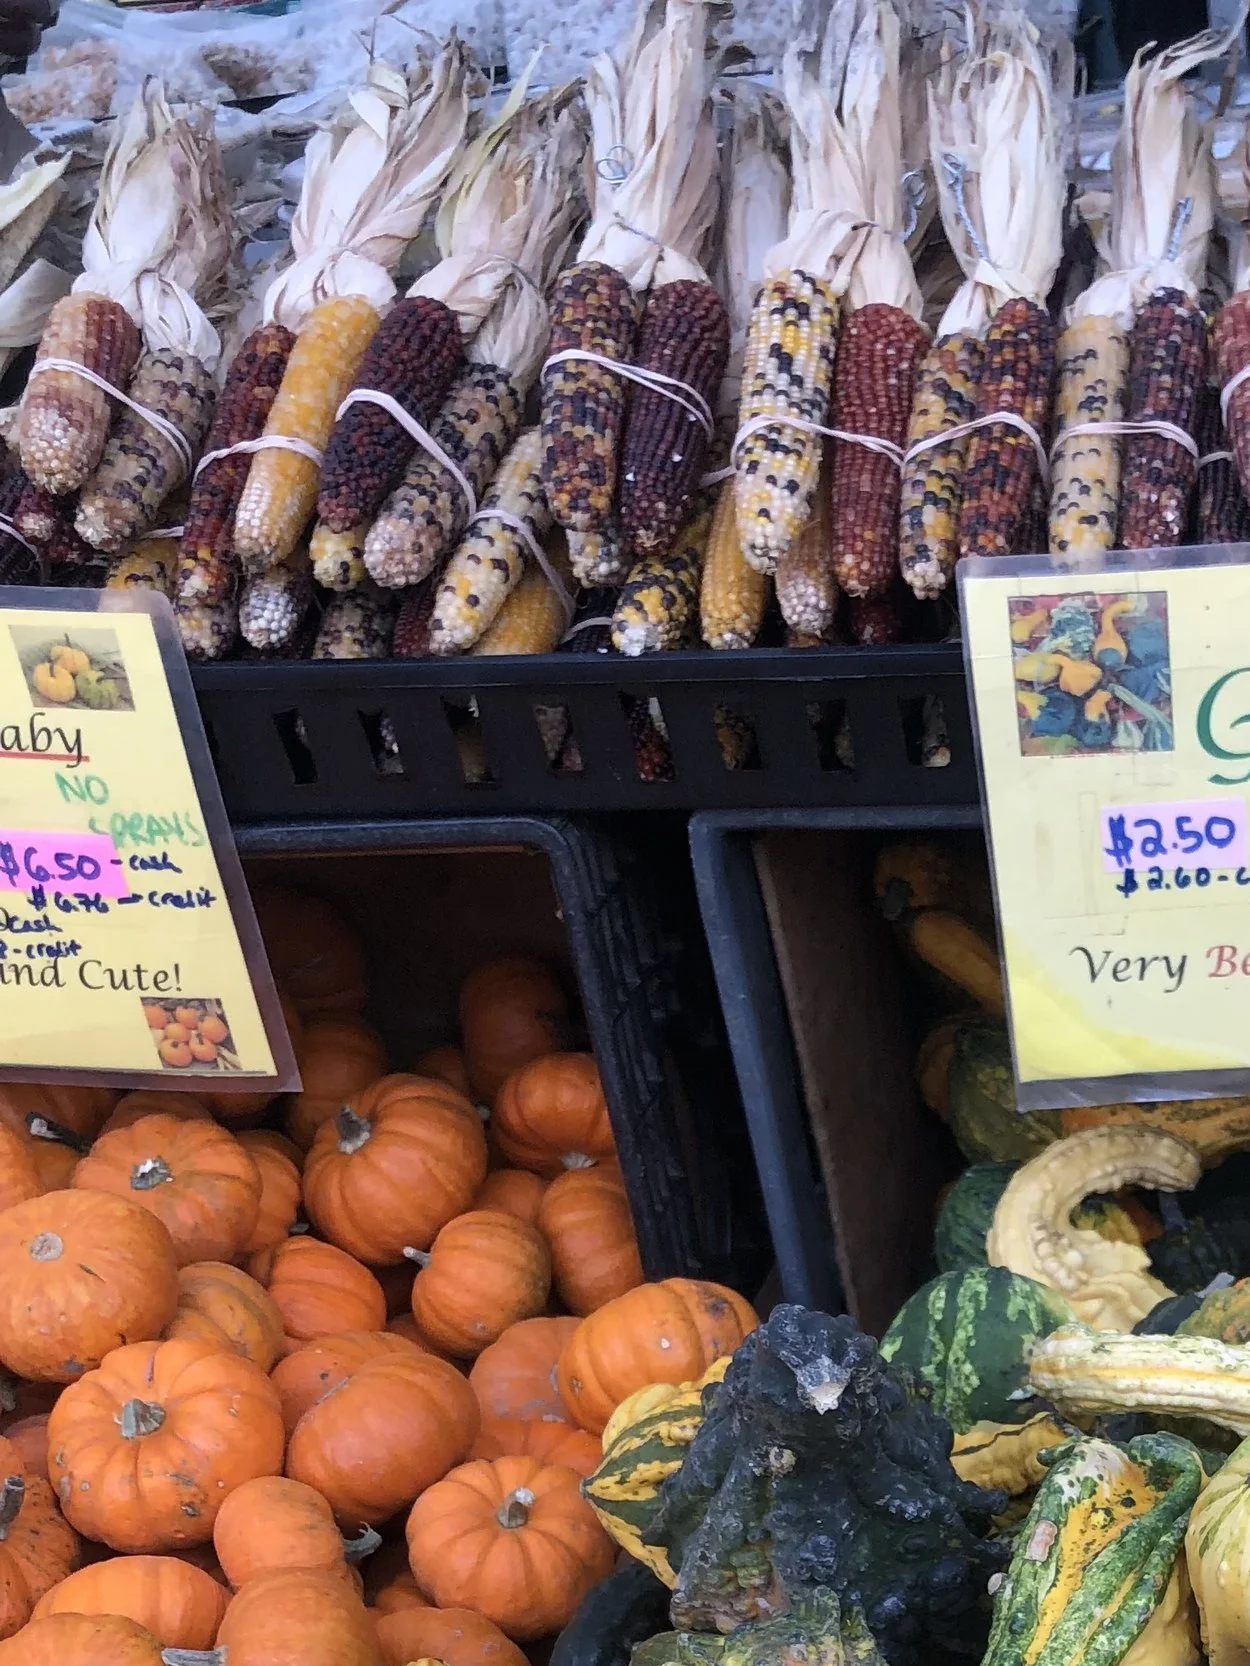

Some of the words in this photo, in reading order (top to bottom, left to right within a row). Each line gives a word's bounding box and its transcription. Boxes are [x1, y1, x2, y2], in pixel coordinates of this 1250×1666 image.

[54, 771, 109, 805] NO
[1104, 814, 1236, 867] $2.50
[78, 959, 183, 992] Cute!
[1069, 947, 1188, 993] Very
